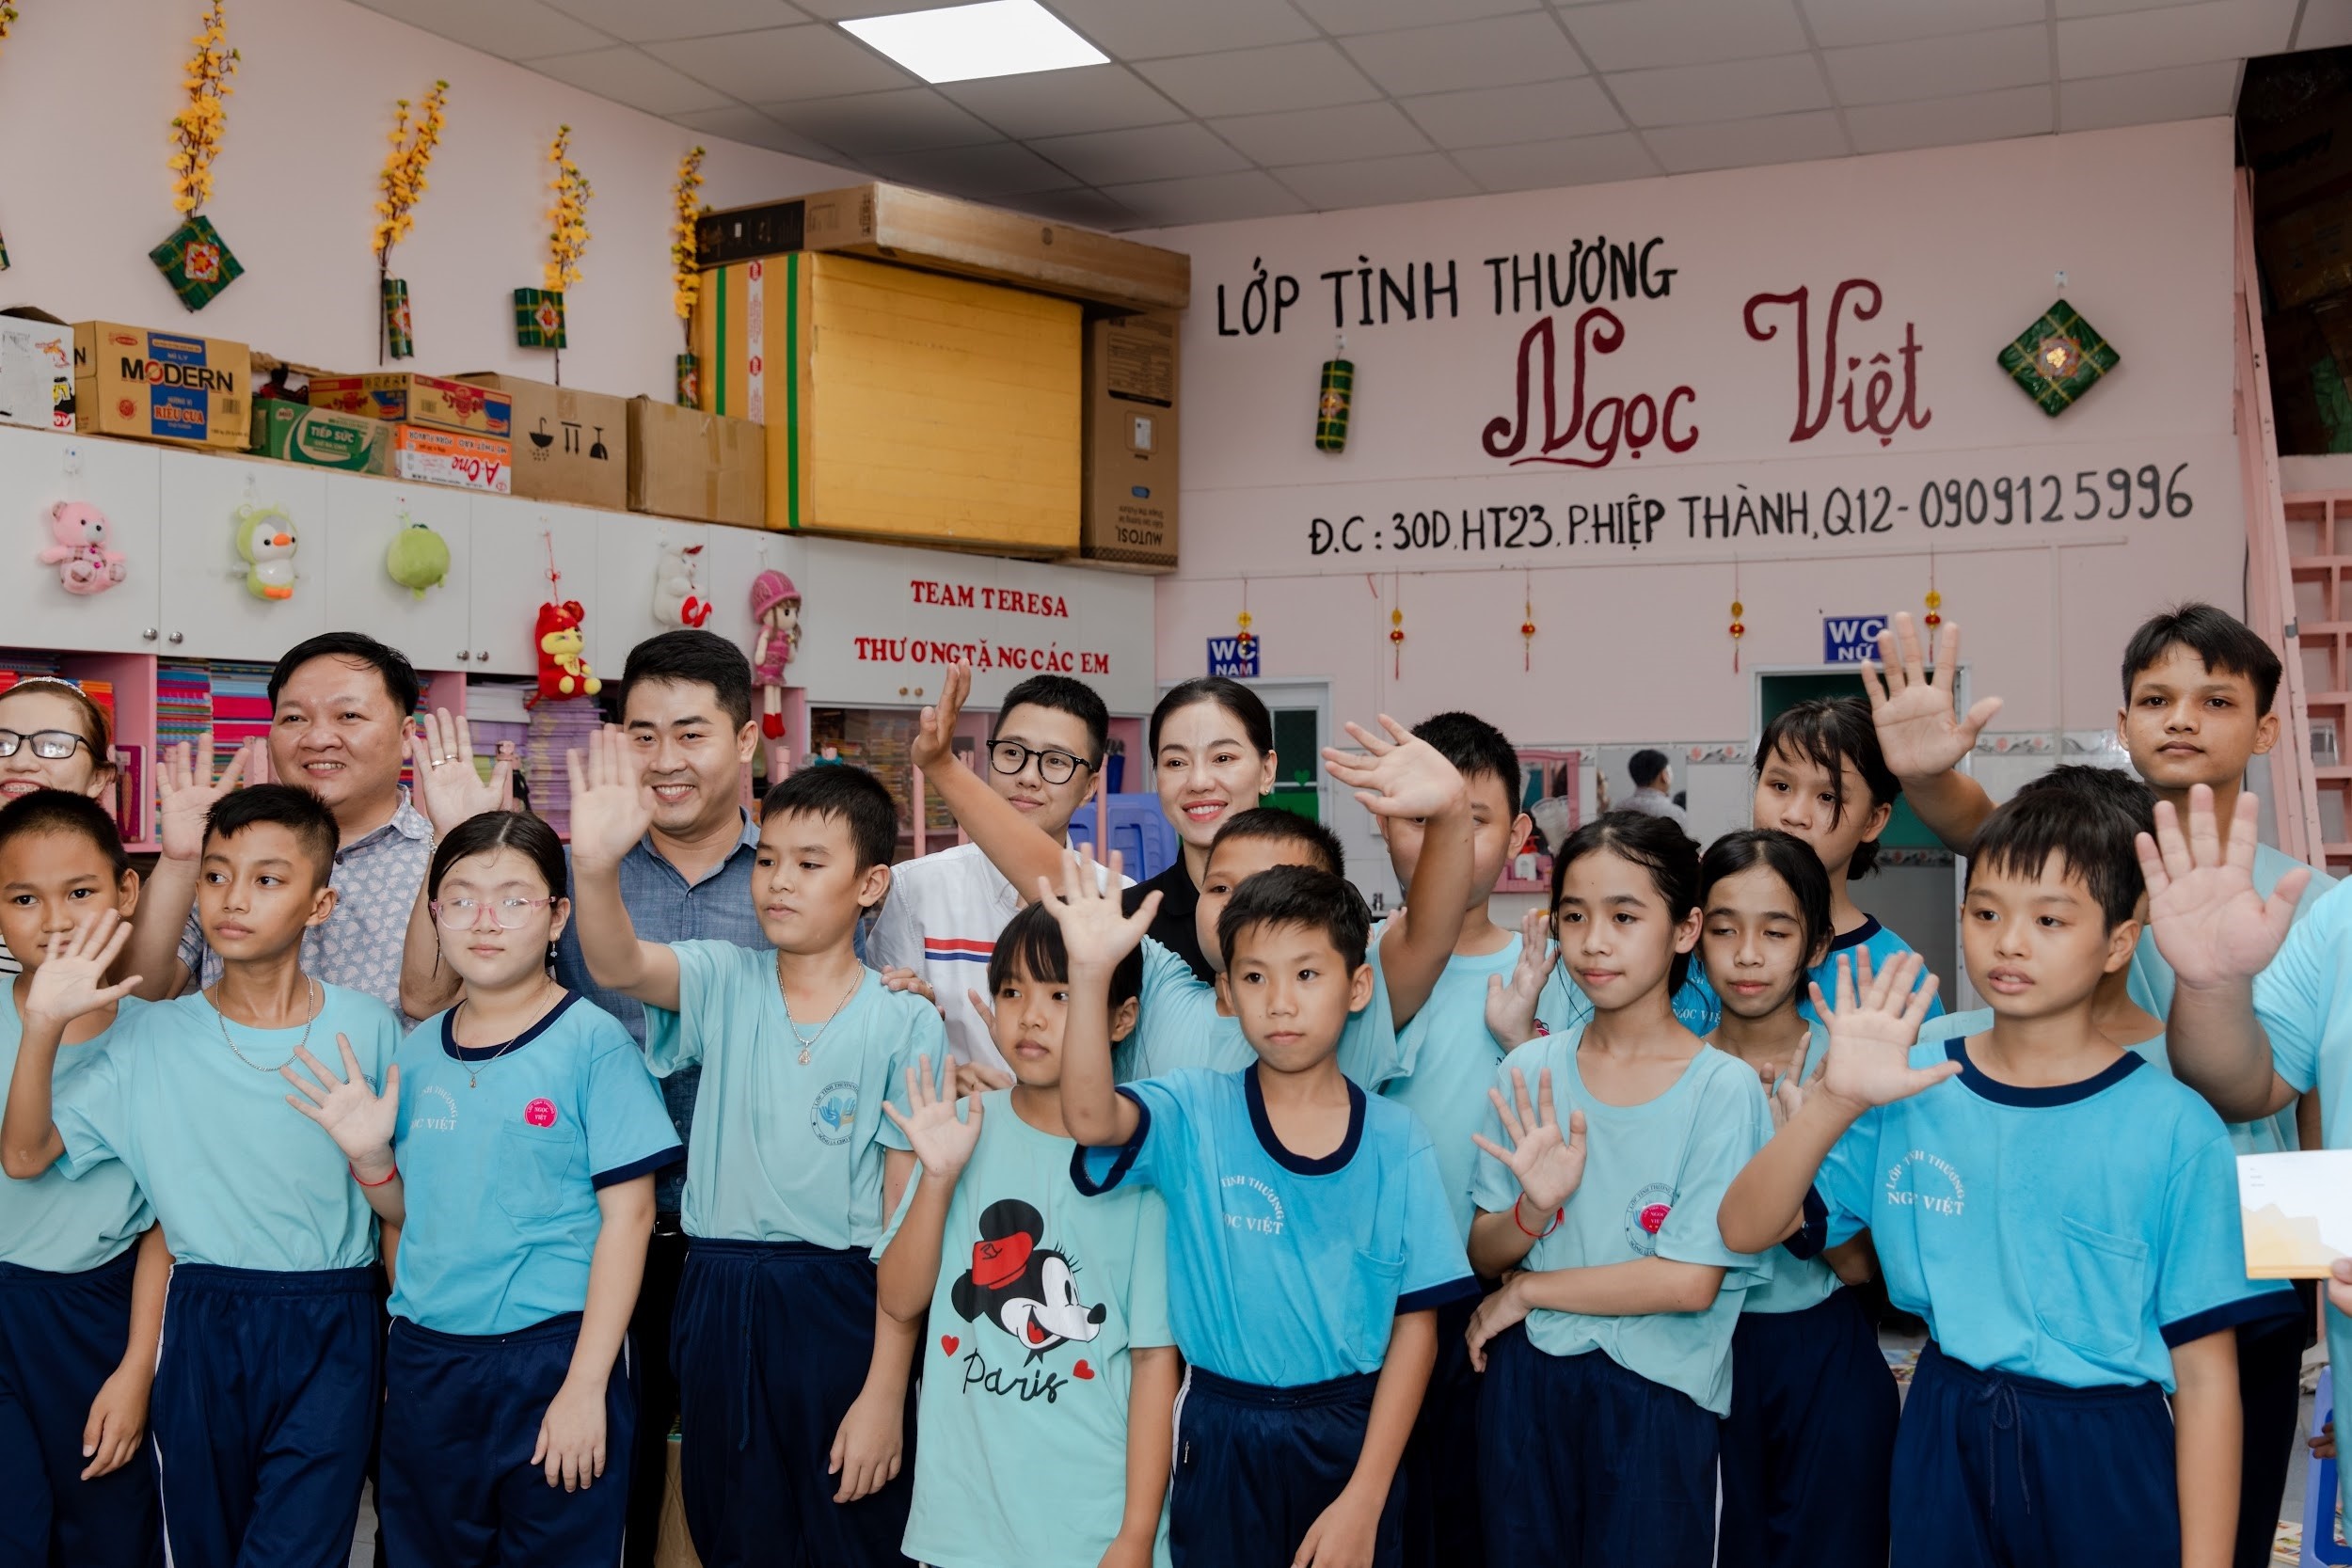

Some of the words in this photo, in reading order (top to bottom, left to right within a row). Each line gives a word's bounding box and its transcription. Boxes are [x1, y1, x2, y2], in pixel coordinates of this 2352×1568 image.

[1217, 256, 1299, 336] LỚP
[1321, 255, 1458, 328] TÌNH
[1484, 235, 1678, 315] THƯƠNG
[120, 356, 233, 393] MODERN
[1482, 307, 1698, 468] Ngọc
[1743, 278, 1931, 447] Việt
[1919, 462, 2193, 528] 0909125996
[911, 580, 975, 609] TEAM
[981, 588, 1069, 618] TERESA
[1827, 619, 1884, 643] WC
[1030, 641, 1073, 673] CÁC
[1080, 652, 1109, 674] EM
[1211, 640, 1257, 660] WC
[1837, 642, 1874, 661] NỮ
[1215, 662, 1253, 675] NAM
[1248, 1177, 1285, 1220] THƯƠNG
[1923, 1196, 1965, 1216] VIỆT
[1246, 1215, 1284, 1235] VIỆT
[962, 1348, 1069, 1403] Paris
